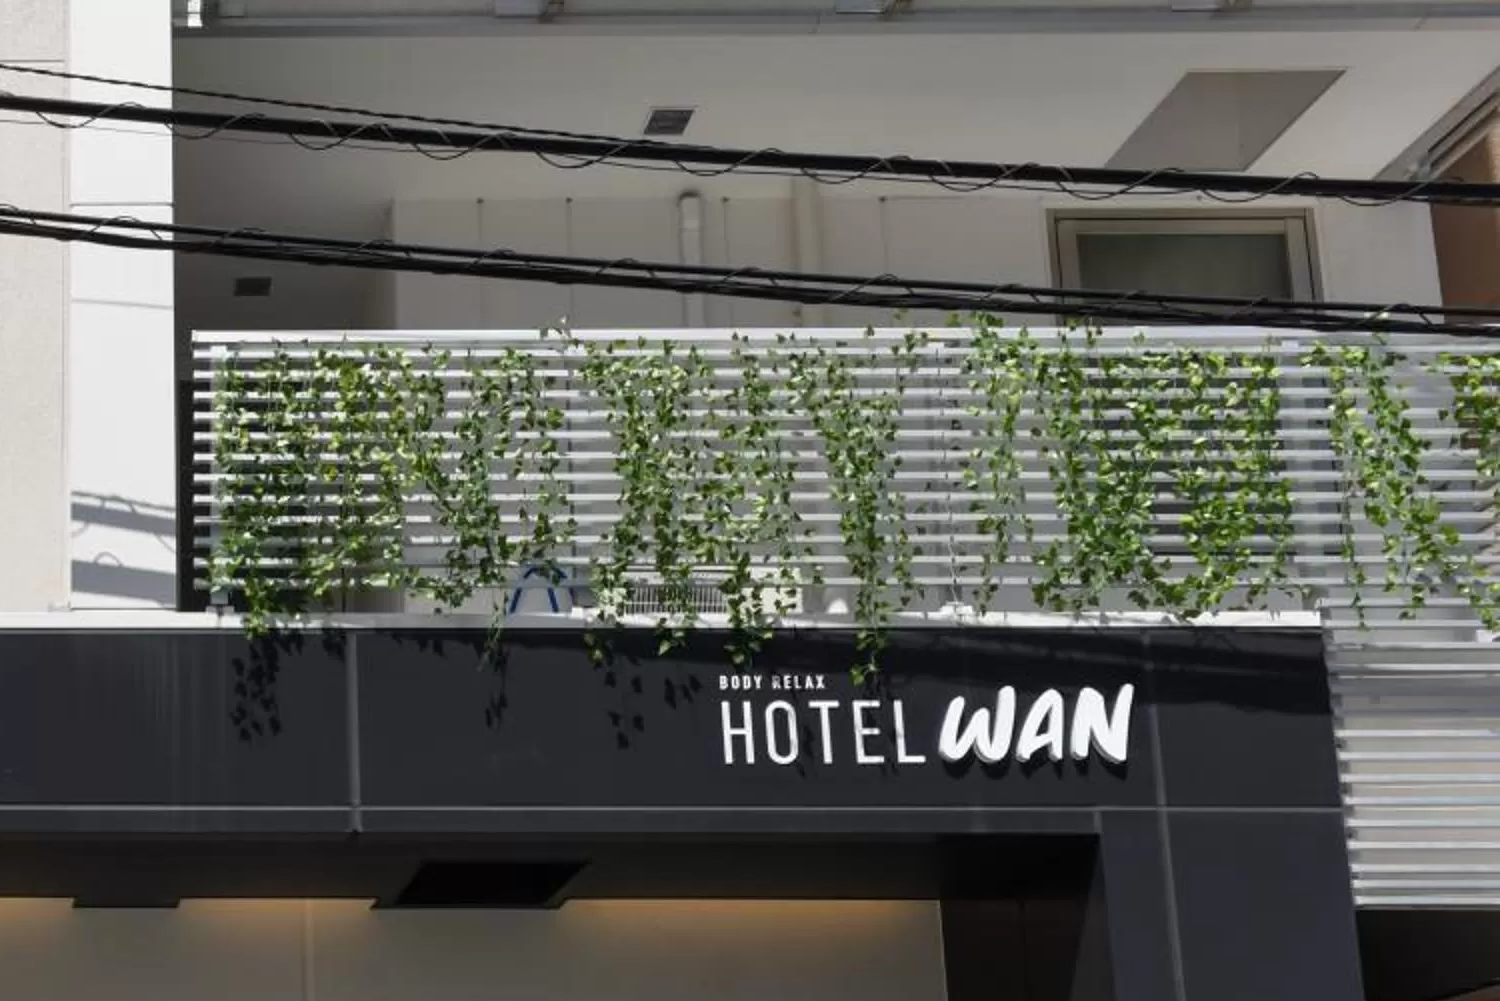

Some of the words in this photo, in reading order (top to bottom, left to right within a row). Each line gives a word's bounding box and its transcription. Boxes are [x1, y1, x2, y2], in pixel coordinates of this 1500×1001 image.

[719, 675, 762, 690] BODY
[771, 675, 825, 690] RELAX
[721, 700, 926, 765] HOTEL
[938, 684, 1134, 764] WAN
